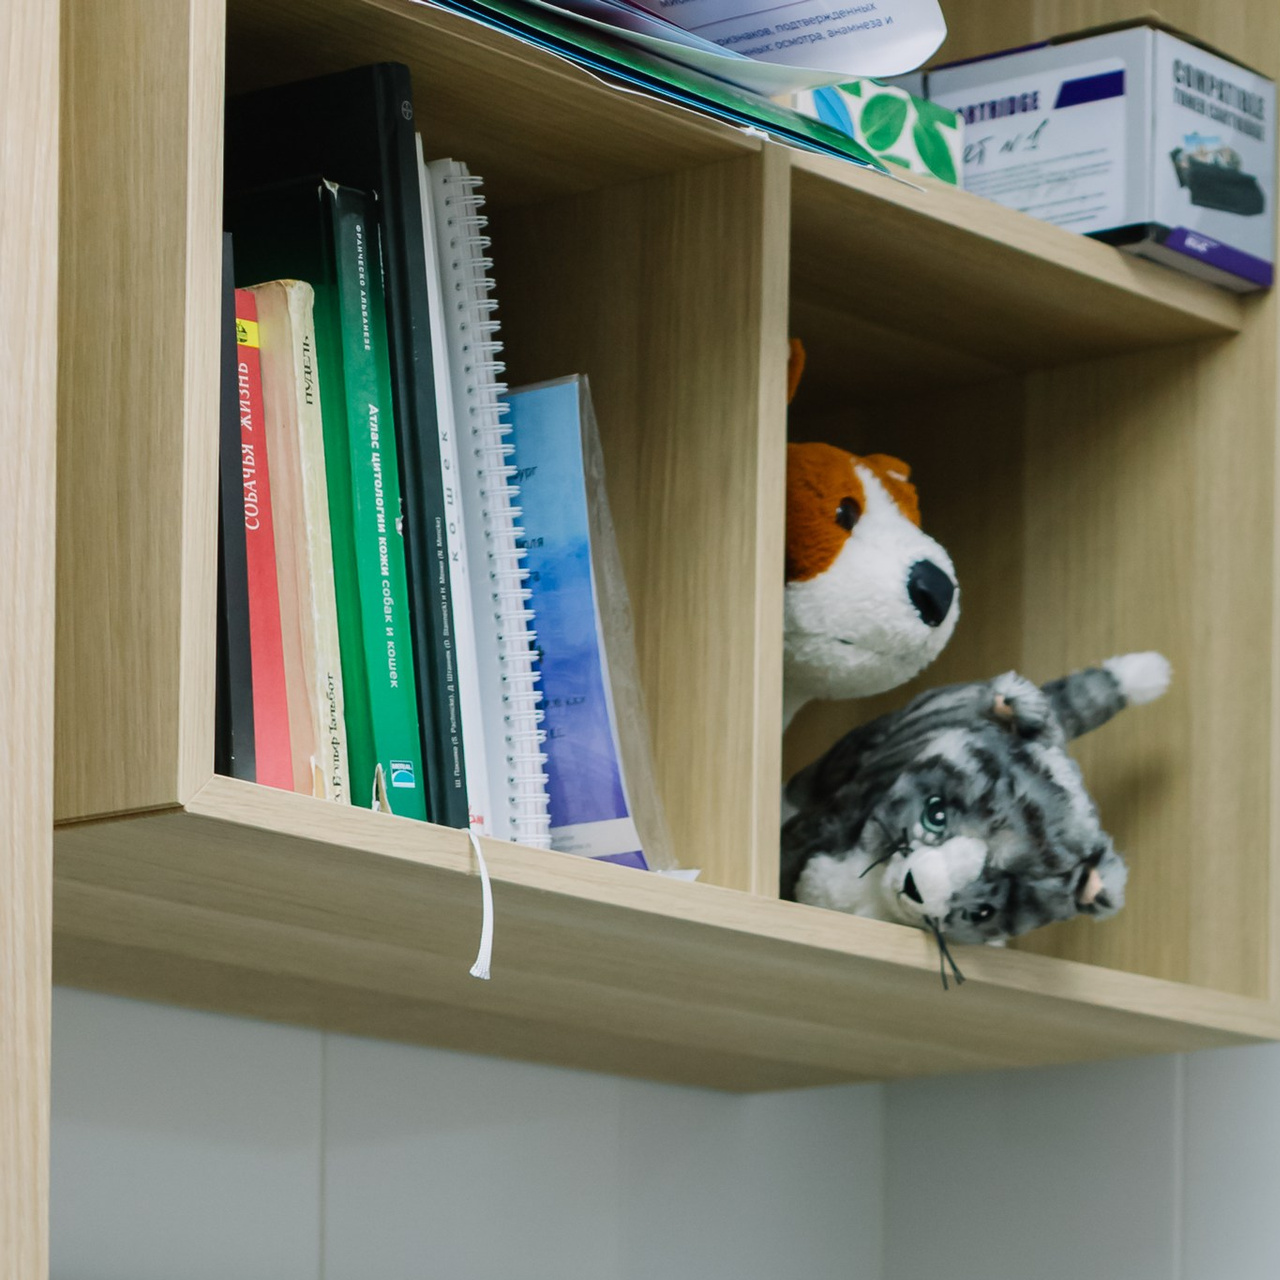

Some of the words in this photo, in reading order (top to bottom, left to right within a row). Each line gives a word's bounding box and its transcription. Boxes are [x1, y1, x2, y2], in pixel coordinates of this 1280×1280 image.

[710, 25, 771, 47] ризнаков,
[774, 2, 877, 32] подтвержденных
[827, 18, 883, 39] анамнеза
[885, 15, 893, 26] и
[955, 90, 1039, 125] RTRIDGE
[355, 224, 366, 287] ФРАНЧЕСКО
[360, 289, 371, 351] АЛЬБАНЕЗЕ
[302, 335, 314, 406] ПУДЕЛЬ
[238, 362, 253, 431] ЖИЗНЬ
[368, 403, 380, 449] Атлас
[241, 444, 260, 530] СОБАЧЬЯ
[370, 453, 387, 533] цитологии
[378, 537, 390, 576] кожи
[381, 579, 395, 623] собак
[385, 627, 394, 637] и
[386, 640, 399, 689] кошек
